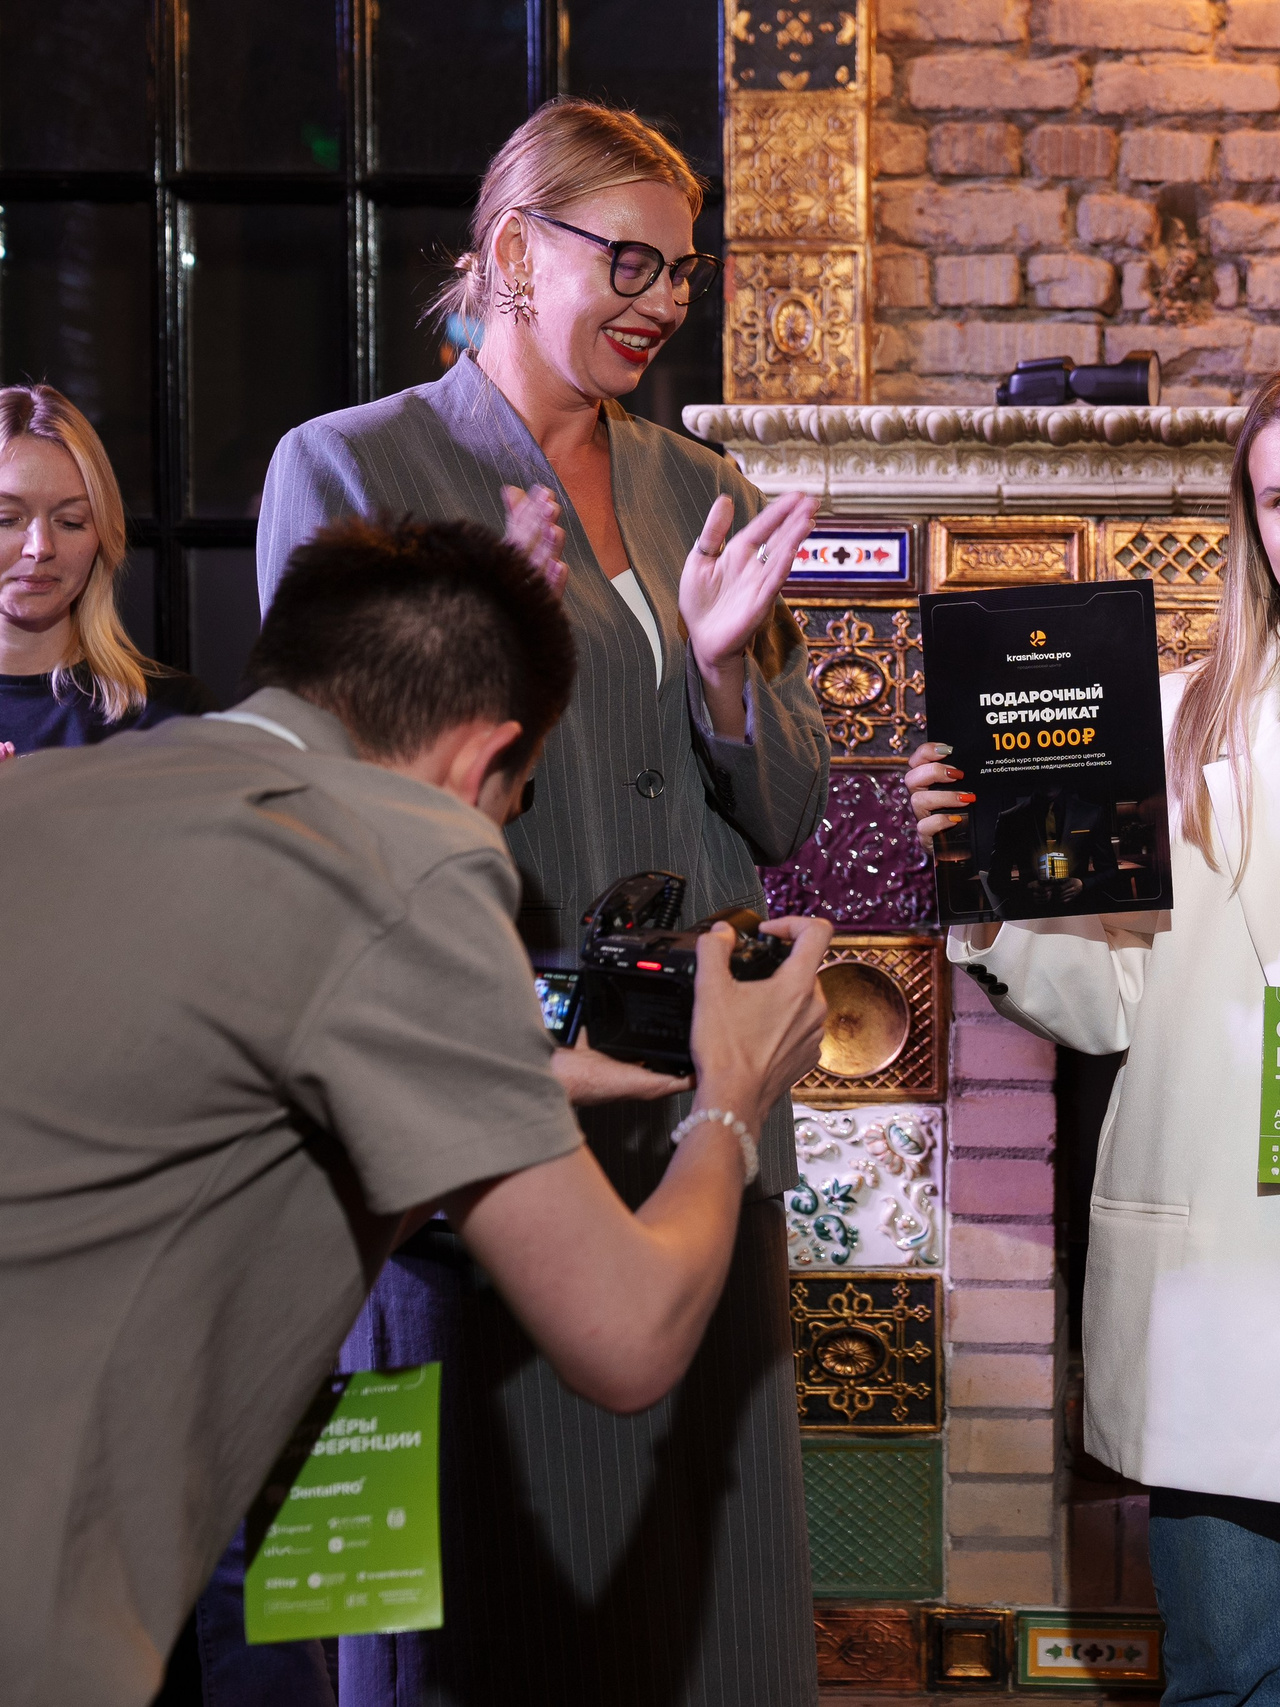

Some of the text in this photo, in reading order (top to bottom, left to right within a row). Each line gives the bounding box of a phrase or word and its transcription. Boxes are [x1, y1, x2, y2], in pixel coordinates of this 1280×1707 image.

[1006, 651, 1072, 663] krasnikova.pro
[979, 683, 1104, 707] ПОДАРОЧНЫЙ
[985, 705, 1100, 725] СЕРТИФИКАТ
[992, 731, 1031, 751] 100
[980, 759, 1112, 775] для собственников медицинского бизнеса
[994, 757, 1016, 765] любой
[1016, 756, 1032, 766] курс
[1032, 753, 1082, 763] продюсерского
[1082, 751, 1106, 760] центра
